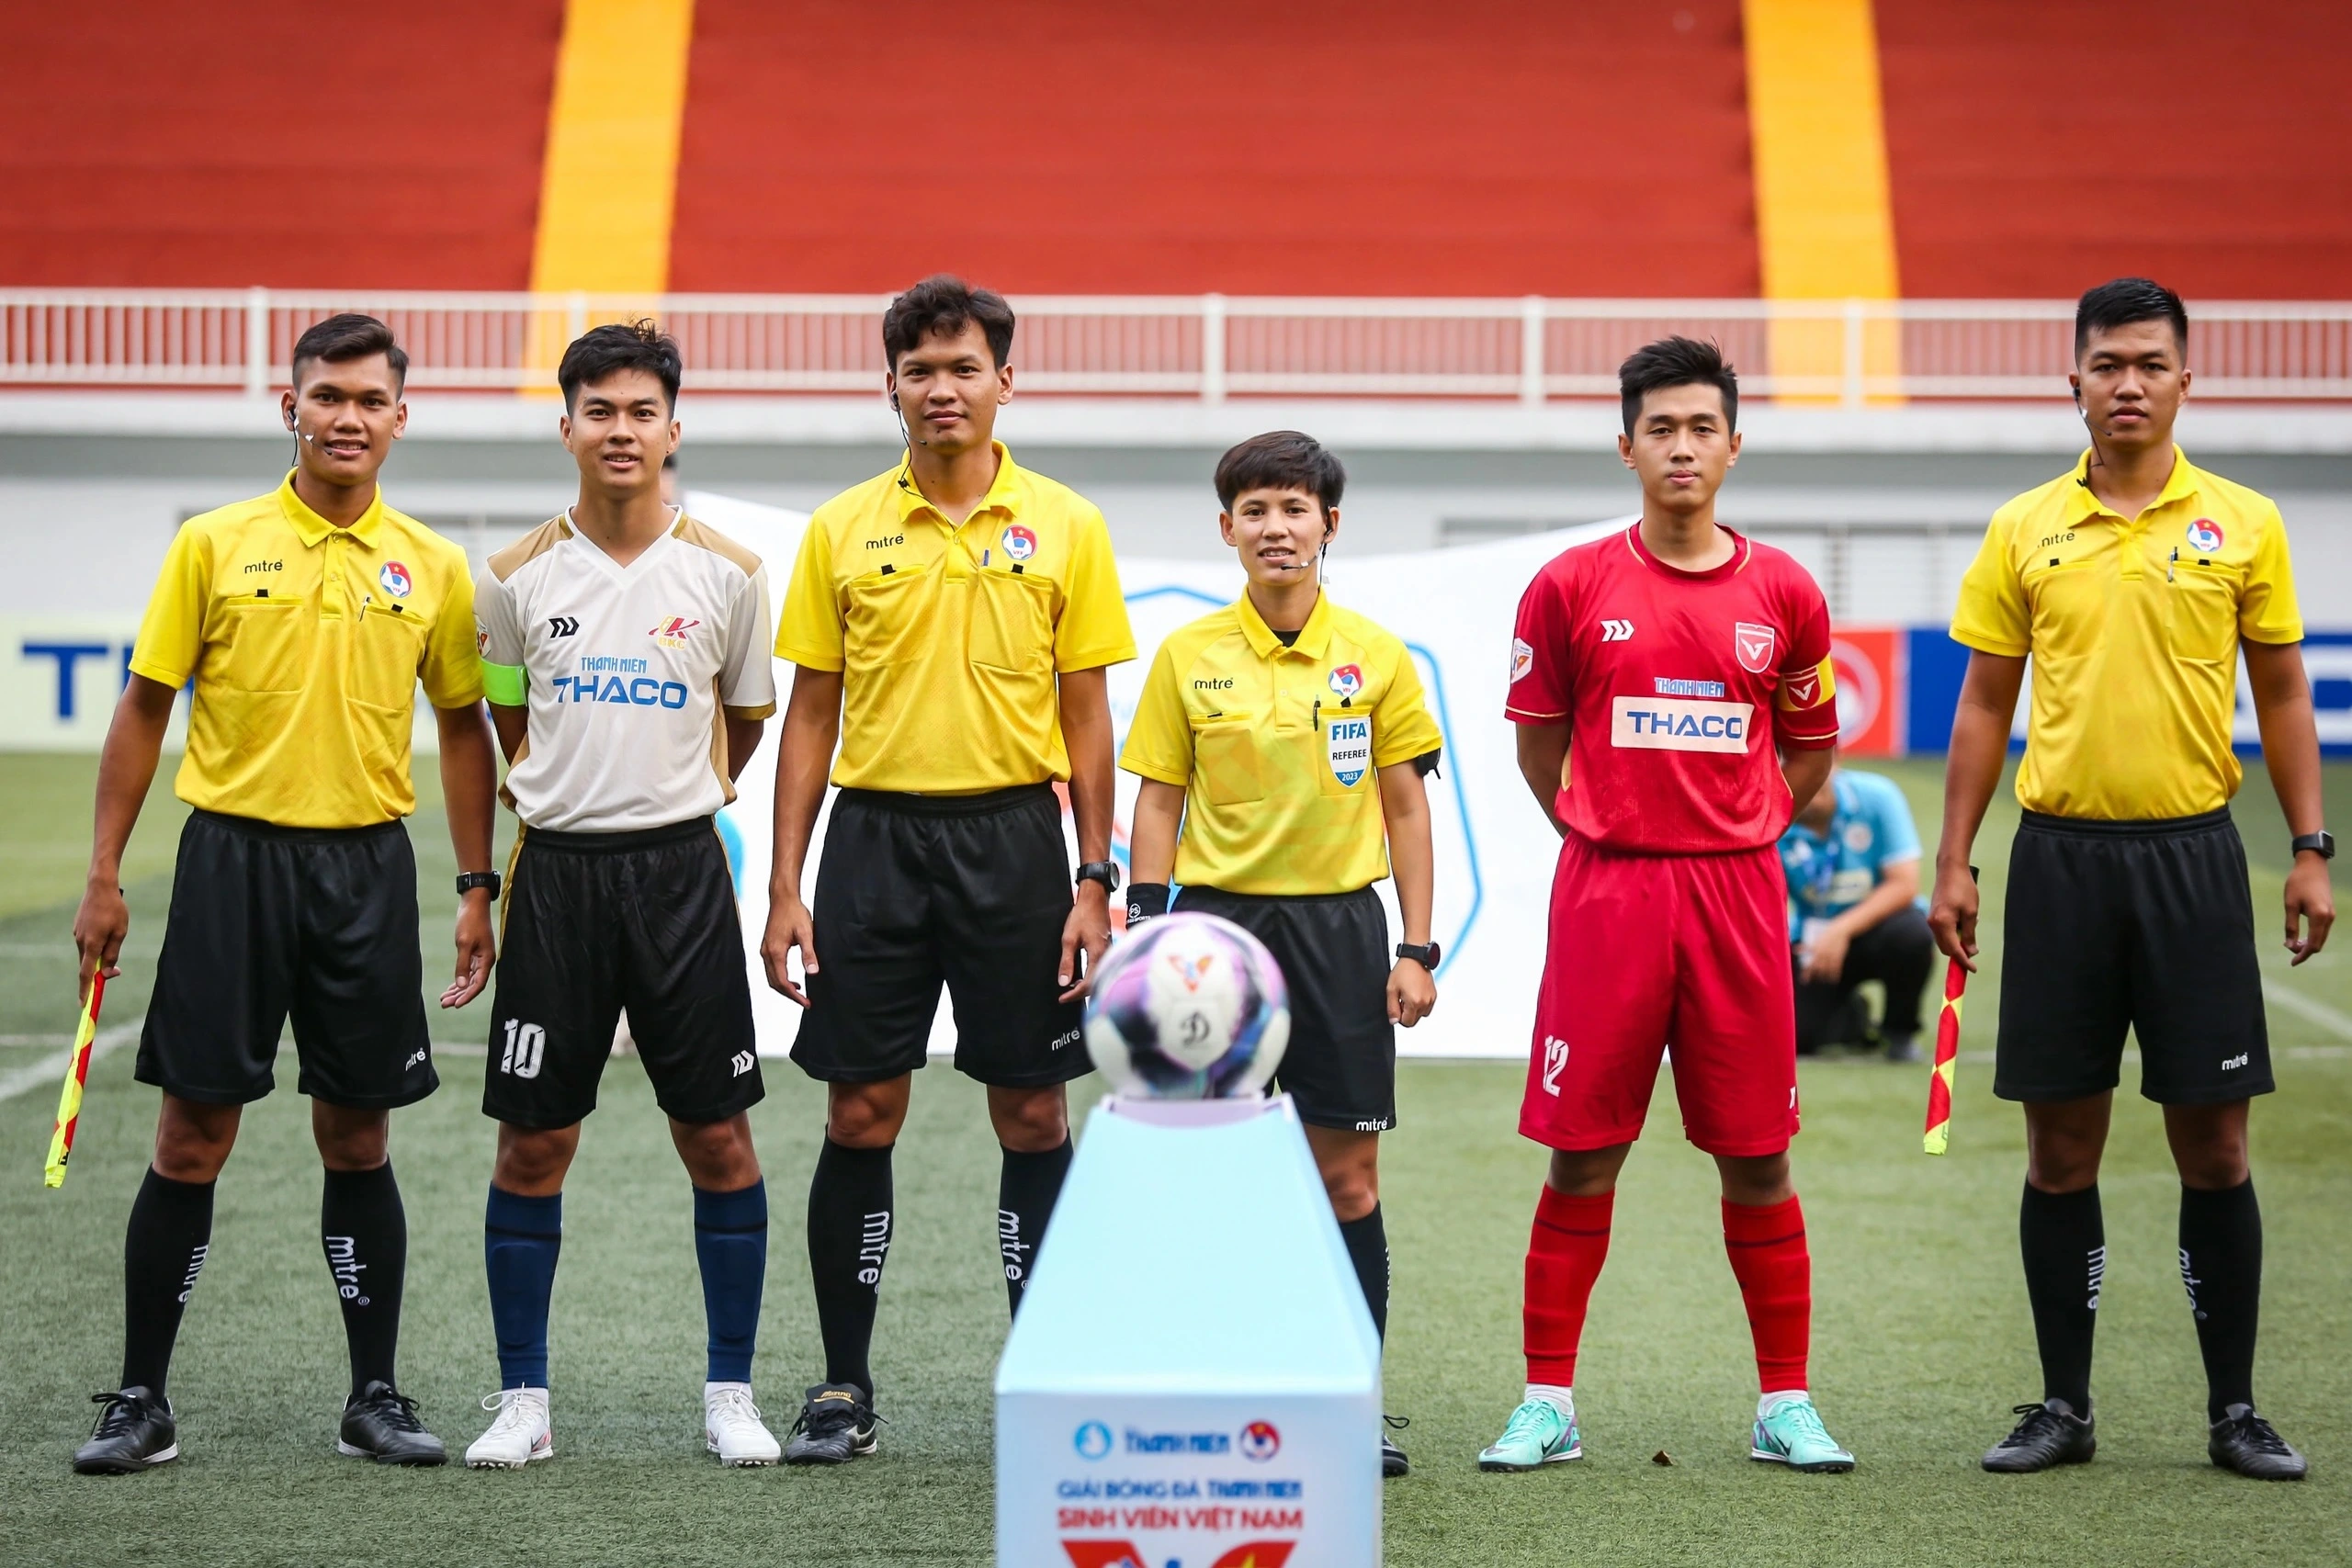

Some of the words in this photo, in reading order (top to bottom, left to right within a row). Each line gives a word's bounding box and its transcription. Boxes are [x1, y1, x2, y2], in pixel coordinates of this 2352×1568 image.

[865, 534, 904, 549] mitre
[244, 560, 283, 574] mitre
[581, 656, 618, 672] THANH
[552, 675, 688, 709] THACO
[1194, 678, 1233, 690] mitre
[1655, 677, 1695, 695] THANH
[1331, 722, 1367, 741] FIFA
[1626, 711, 1743, 739] THACO
[1332, 749, 1367, 761] REFEREE
[1341, 772, 1358, 782] 2023
[501, 1018, 547, 1079] 10
[1051, 1030, 1080, 1051] mitre
[1543, 1034, 1569, 1098] 12
[2222, 1054, 2248, 1070] mitre
[1355, 1118, 1387, 1132] mitre
[857, 1211, 890, 1284] mitre
[999, 1209, 1030, 1280] mitre
[326, 1235, 368, 1300] mitre
[1241, 1506, 1303, 1529] NAM
